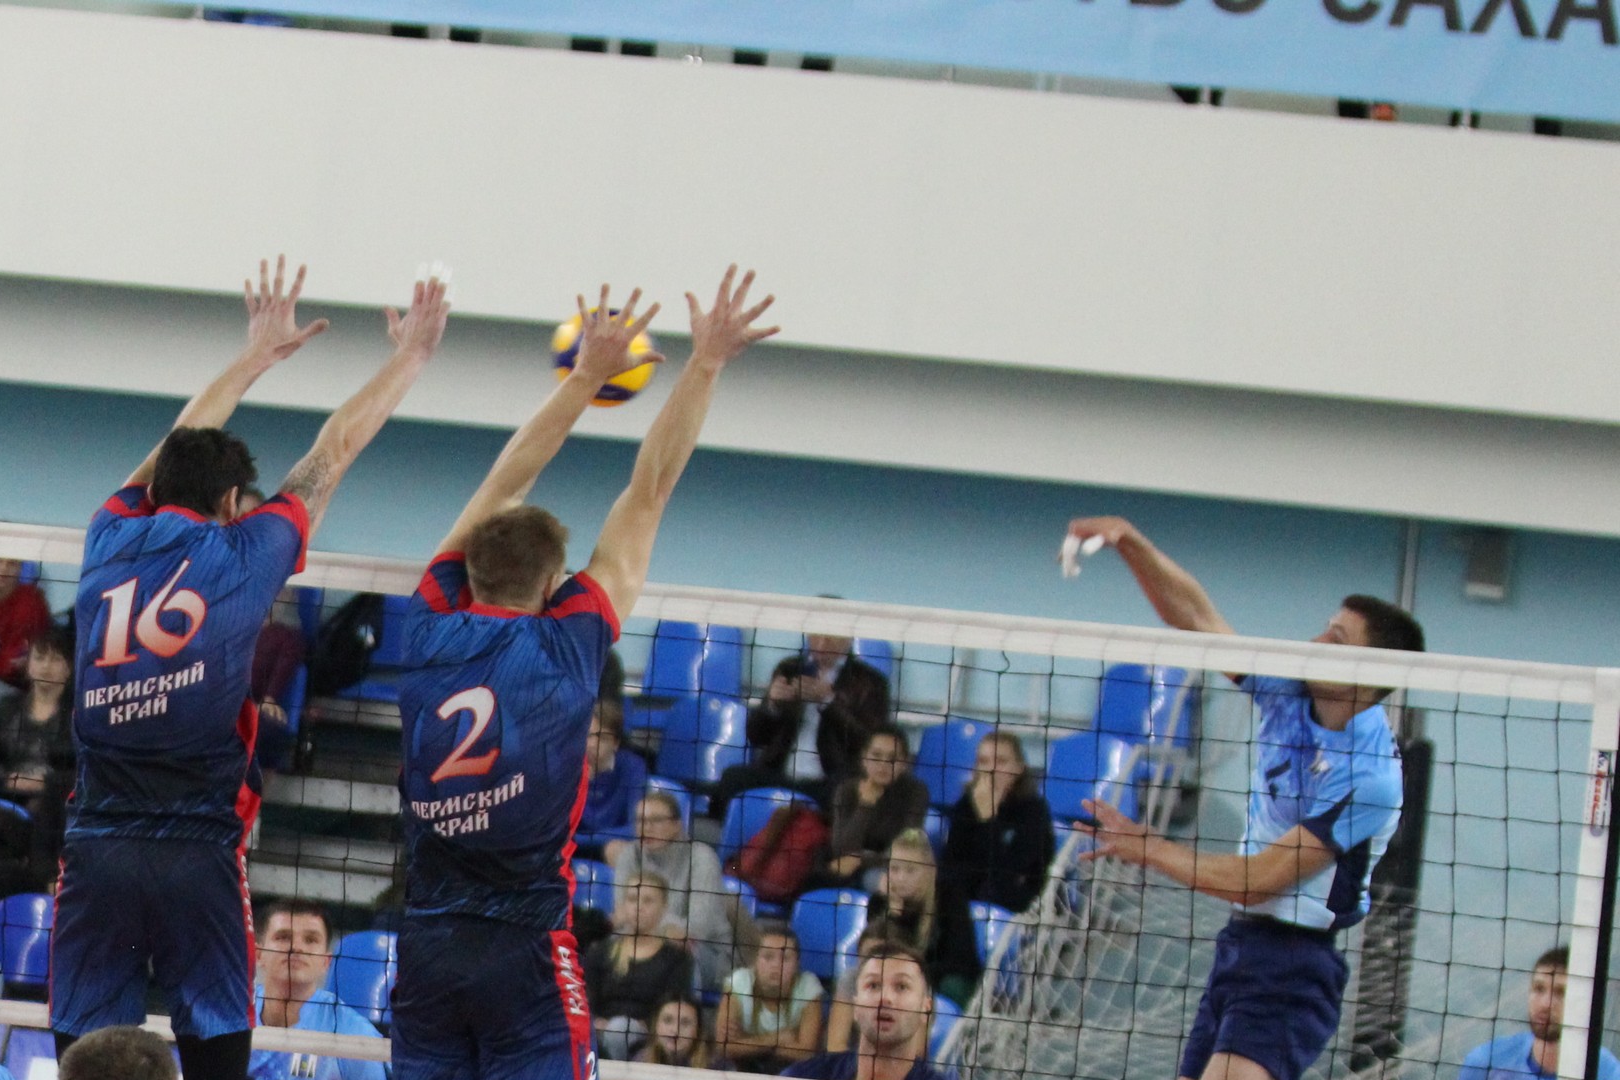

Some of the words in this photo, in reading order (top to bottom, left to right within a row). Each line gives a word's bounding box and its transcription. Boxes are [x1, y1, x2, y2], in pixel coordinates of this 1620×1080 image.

[94, 560, 208, 668] 16
[85, 661, 206, 709] ПЕРМСКИЙ
[109, 694, 169, 726] КРАЙ
[430, 685, 499, 785] 2
[411, 772, 525, 822] ПЕРМСКИЙ
[433, 809, 491, 838] КРАЙ
